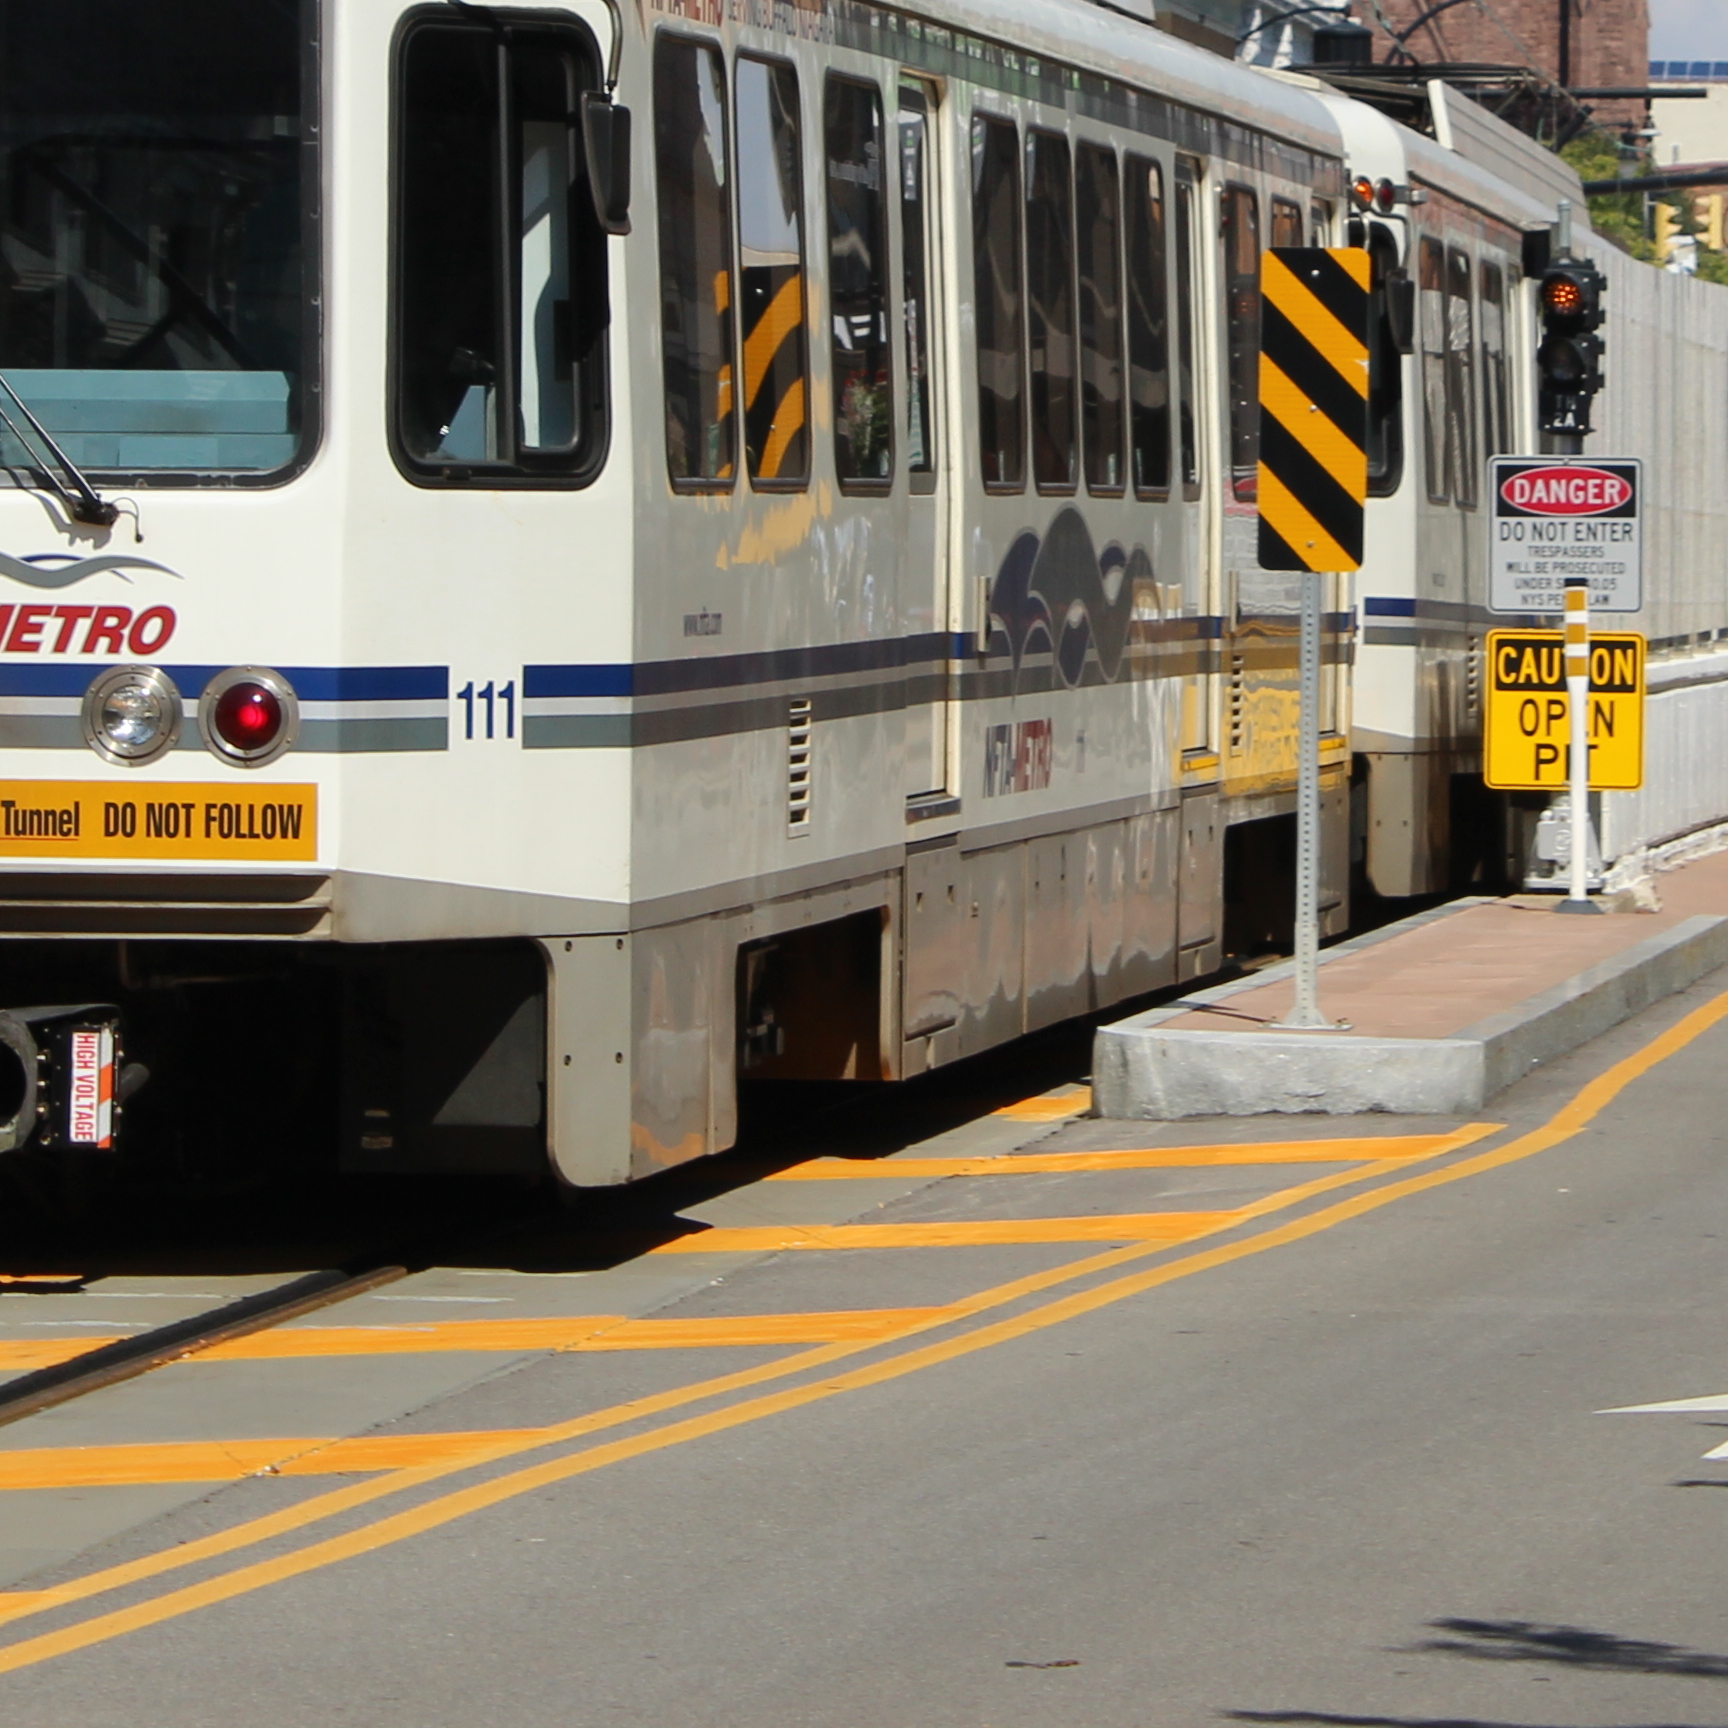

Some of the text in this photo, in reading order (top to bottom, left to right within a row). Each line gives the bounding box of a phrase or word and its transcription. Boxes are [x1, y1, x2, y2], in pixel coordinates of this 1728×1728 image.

[1513, 479, 1622, 504] DANGER
[1499, 522, 1634, 543] DO NOT ENTER
[1527, 545, 1605, 558] TRESPASSERS
[1506, 561, 1626, 575] WILL BE PROSECUTED
[1514, 577, 1552, 590] UNDER
[1497, 646, 1635, 686] CAUON
[456, 680, 516, 740] 111
[1519, 698, 1615, 738] OPN
[981, 717, 1052, 799] NFTA-METRO
[0, 800, 80, 838] Tunnel
[103, 801, 137, 838] DO
[145, 802, 196, 839] NOT
[204, 803, 303, 840] FOLLOW
[73, 1033, 96, 1142] HIGH VOLTAGE
